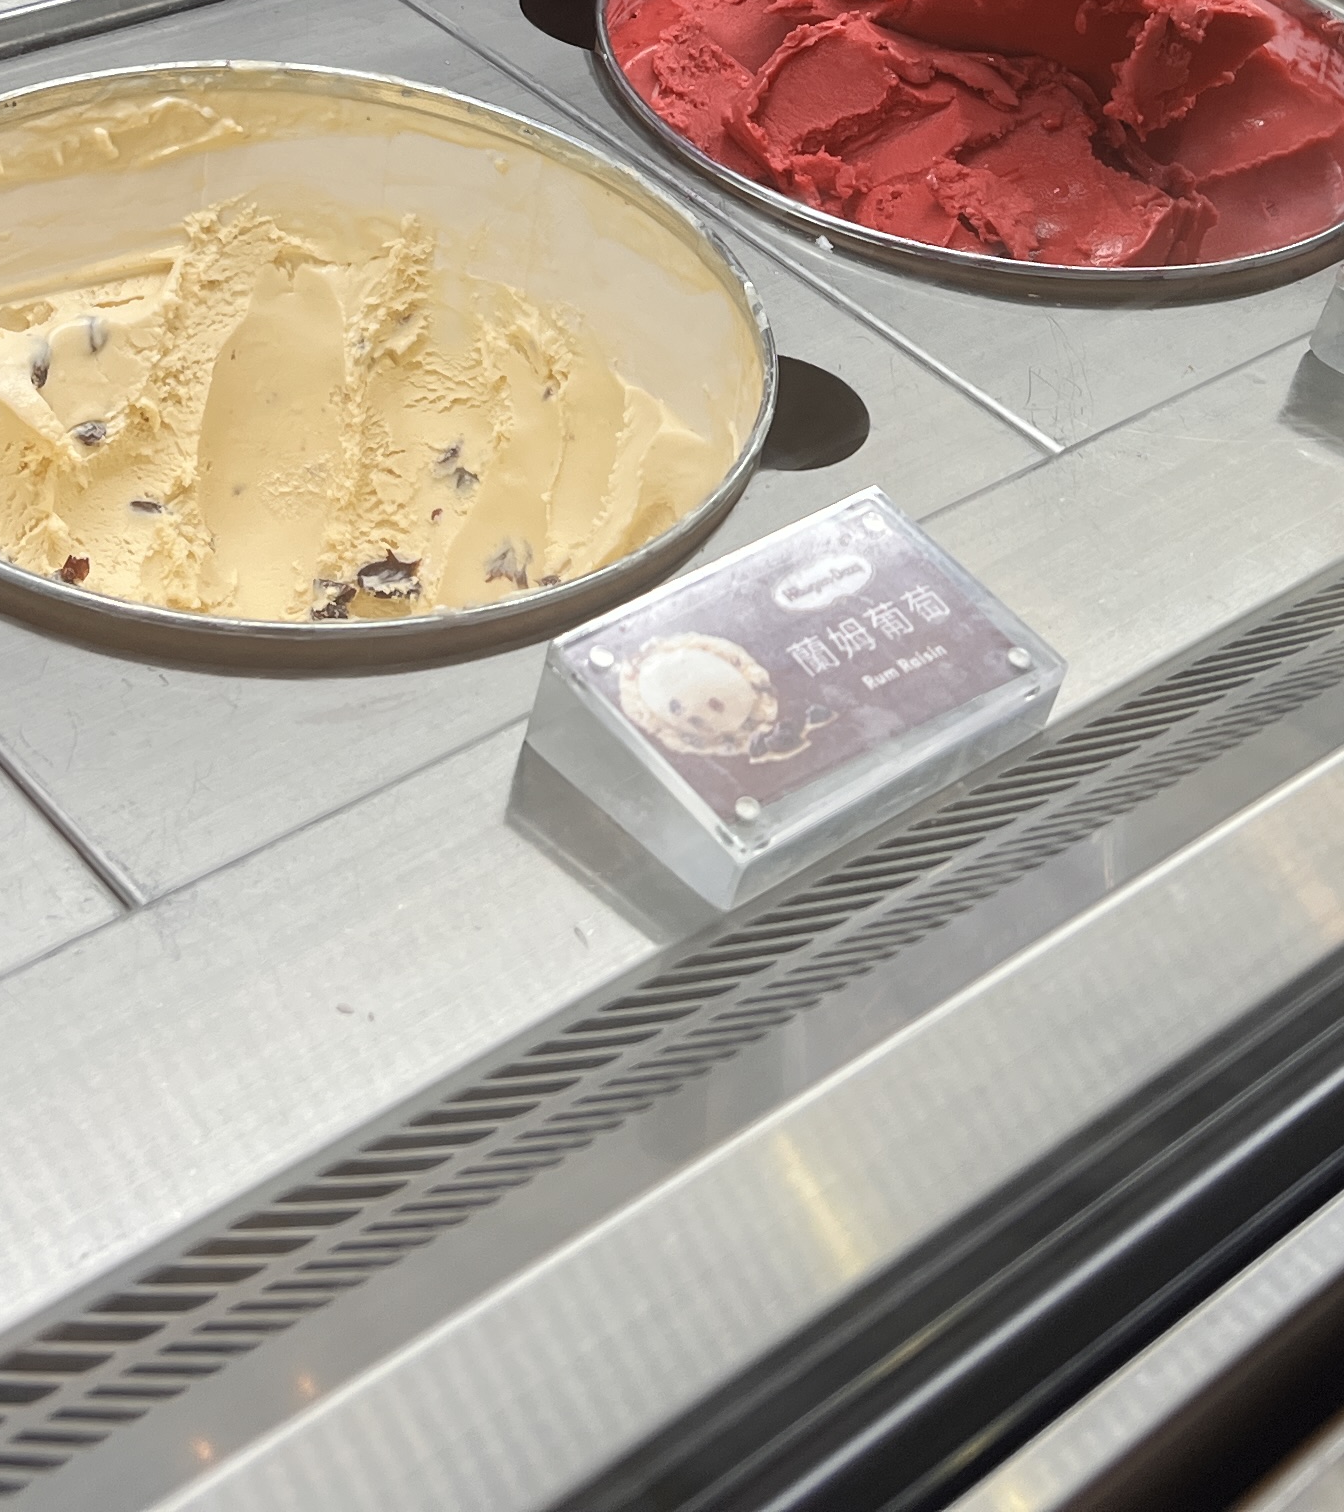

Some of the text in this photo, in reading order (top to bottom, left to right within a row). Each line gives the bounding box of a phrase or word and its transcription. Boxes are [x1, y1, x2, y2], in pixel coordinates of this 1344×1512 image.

[786, 584, 951, 678] 蘭姆葡萄
[861, 644, 948, 690] Rum Raisin
